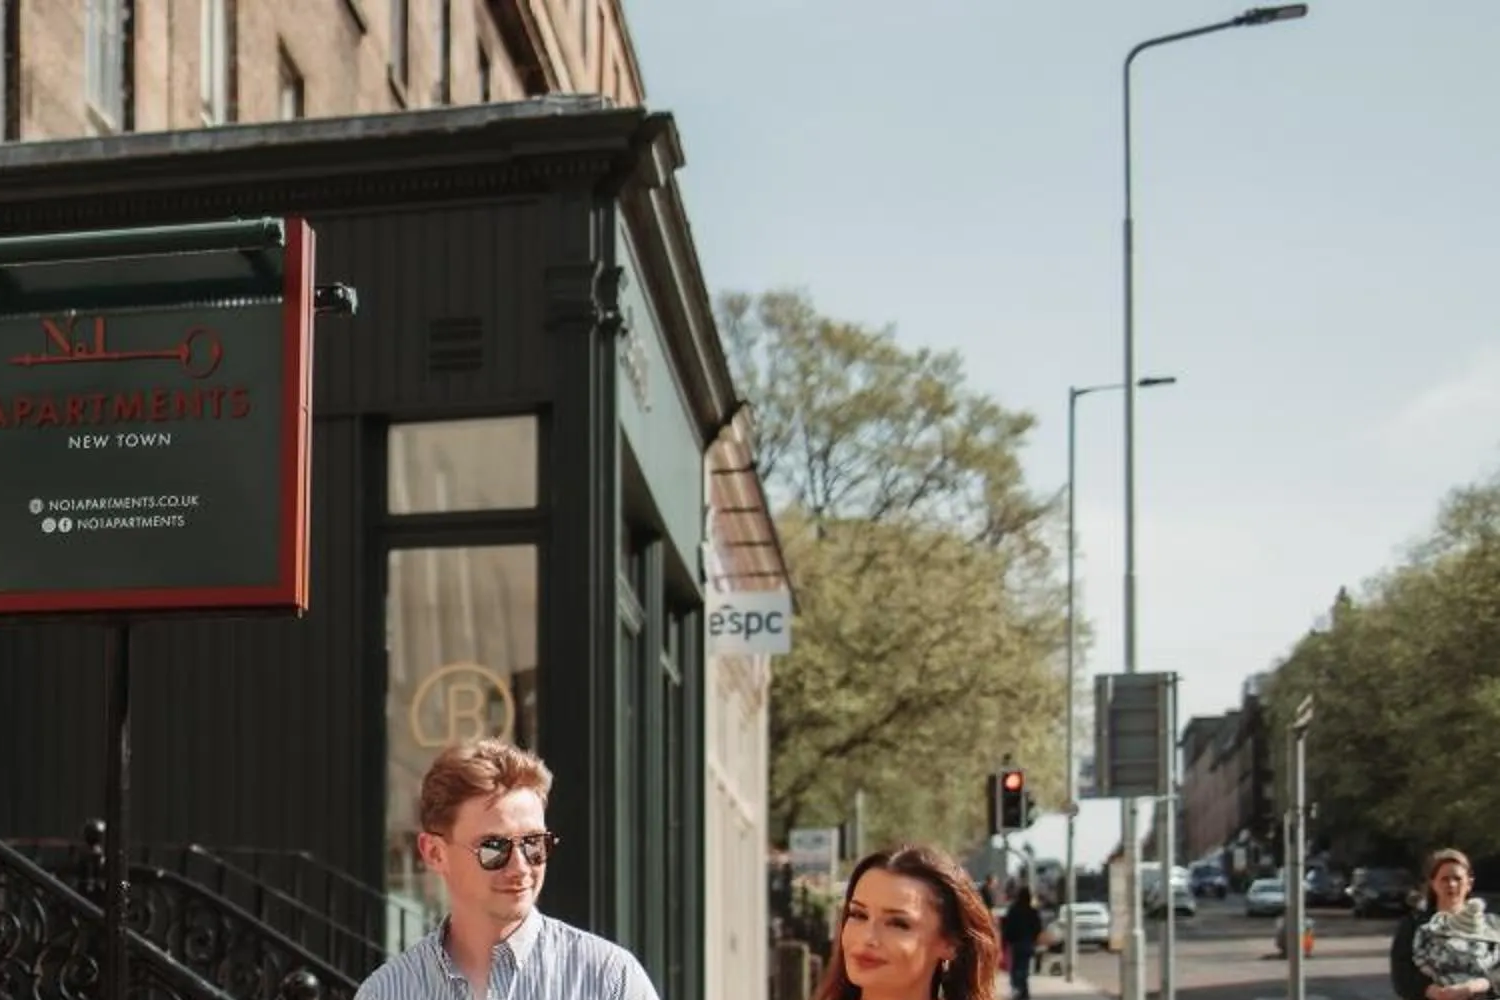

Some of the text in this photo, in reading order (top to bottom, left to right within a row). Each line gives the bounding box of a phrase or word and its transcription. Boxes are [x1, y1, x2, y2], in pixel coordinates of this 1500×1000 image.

[67, 432, 172, 449] NEW TOWN
[709, 608, 783, 641] espc
